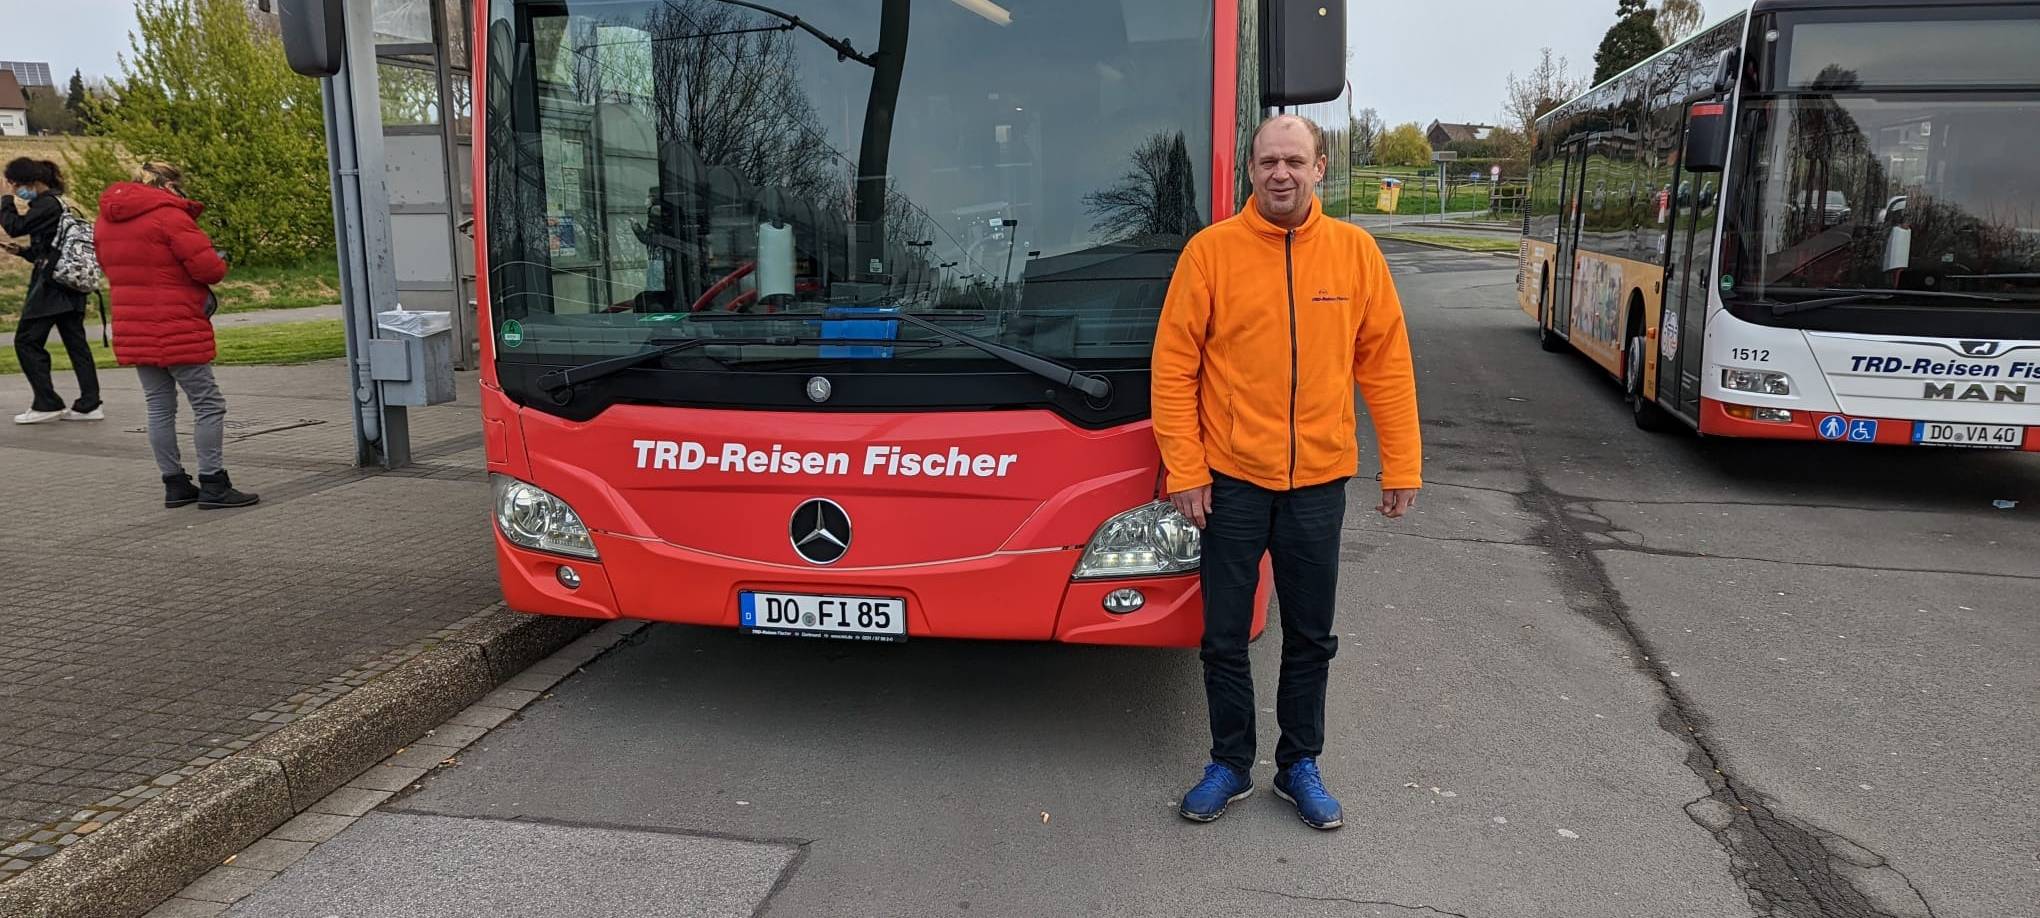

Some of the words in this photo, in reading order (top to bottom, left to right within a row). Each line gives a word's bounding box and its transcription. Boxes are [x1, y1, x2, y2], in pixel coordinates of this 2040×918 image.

[1732, 348, 1770, 362] 1512
[1851, 356, 2000, 377] TRD-Reisen
[1923, 381, 2027, 402] MAN
[1931, 425, 1953, 440] DO
[1967, 427, 1988, 442] VA
[1993, 428, 2015, 443] 40
[633, 440, 850, 475] TRD-Reisen
[862, 446, 1018, 477] Fischer
[766, 597, 800, 624] DO
[818, 600, 851, 627] FI
[858, 602, 891, 629] 85
